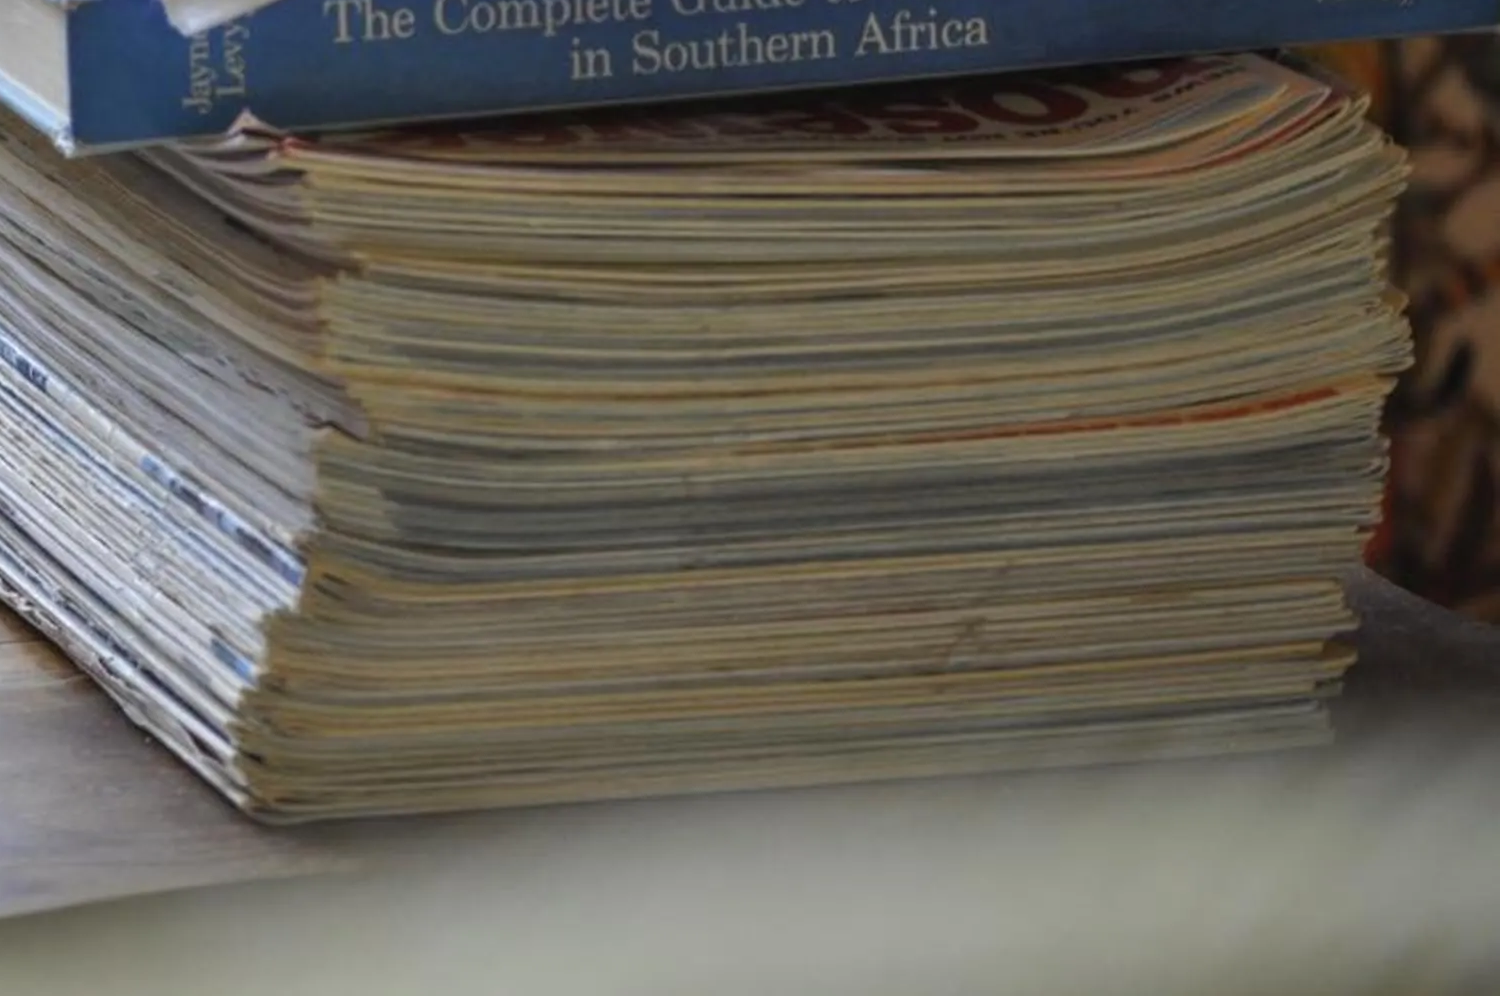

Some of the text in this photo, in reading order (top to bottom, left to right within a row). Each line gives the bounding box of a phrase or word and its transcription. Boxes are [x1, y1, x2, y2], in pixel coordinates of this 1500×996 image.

[569, 8, 989, 80] in Southern Africa
